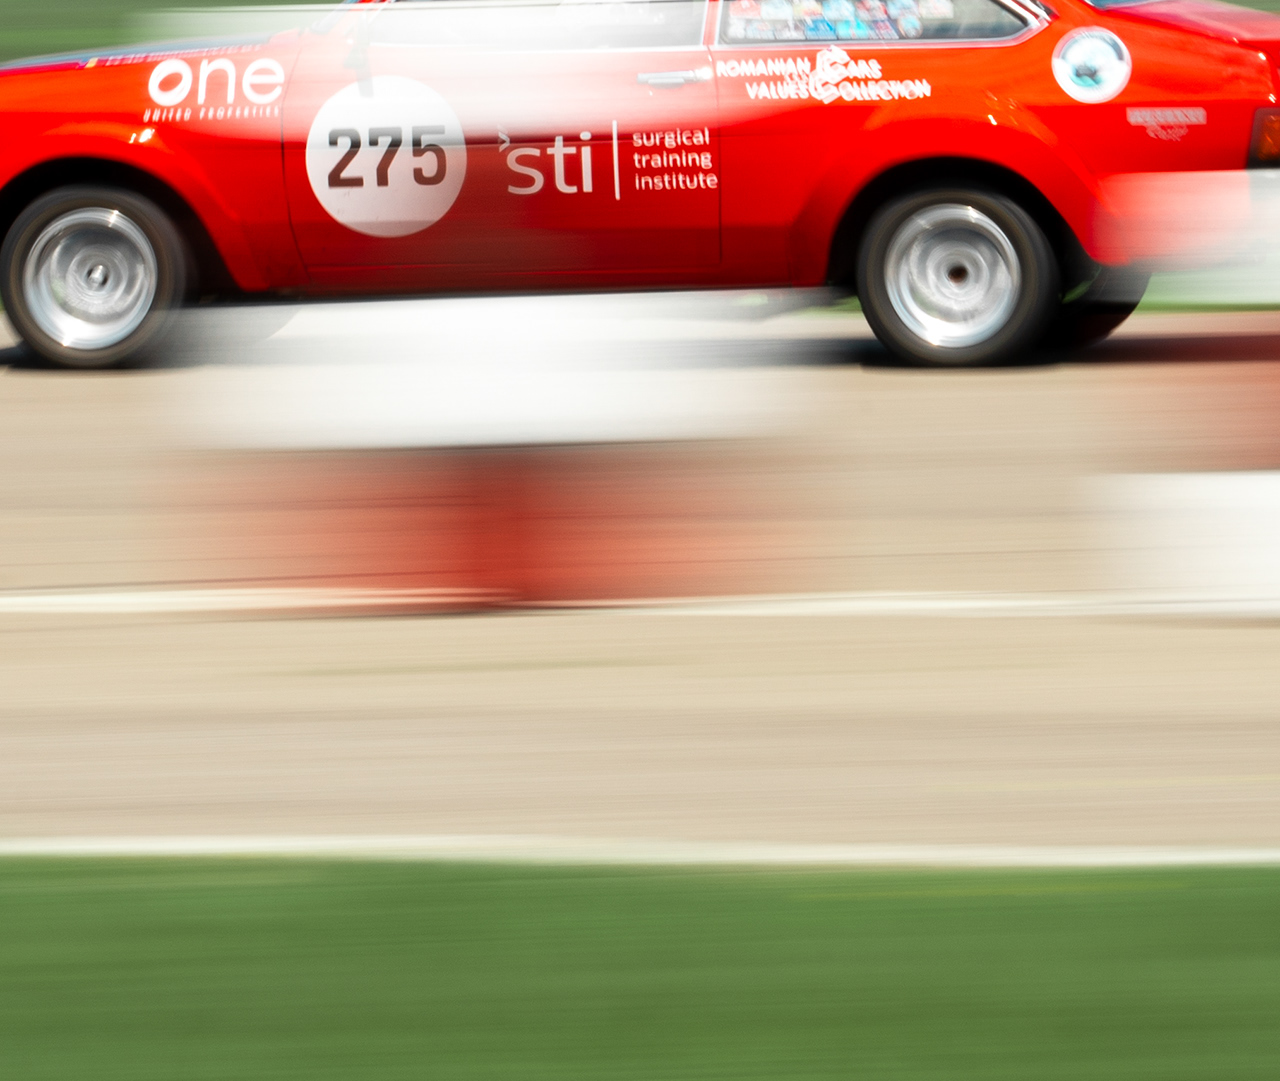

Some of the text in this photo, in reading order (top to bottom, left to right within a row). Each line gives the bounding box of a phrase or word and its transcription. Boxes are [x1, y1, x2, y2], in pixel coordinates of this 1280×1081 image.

[716, 57, 811, 78] ROMANIAN
[147, 58, 285, 107] one
[745, 80, 811, 100] VALUES
[143, 106, 192, 123] UNITED
[632, 126, 711, 149] surgical
[327, 124, 448, 189] 275
[633, 148, 714, 170] training
[634, 170, 719, 191] institute
